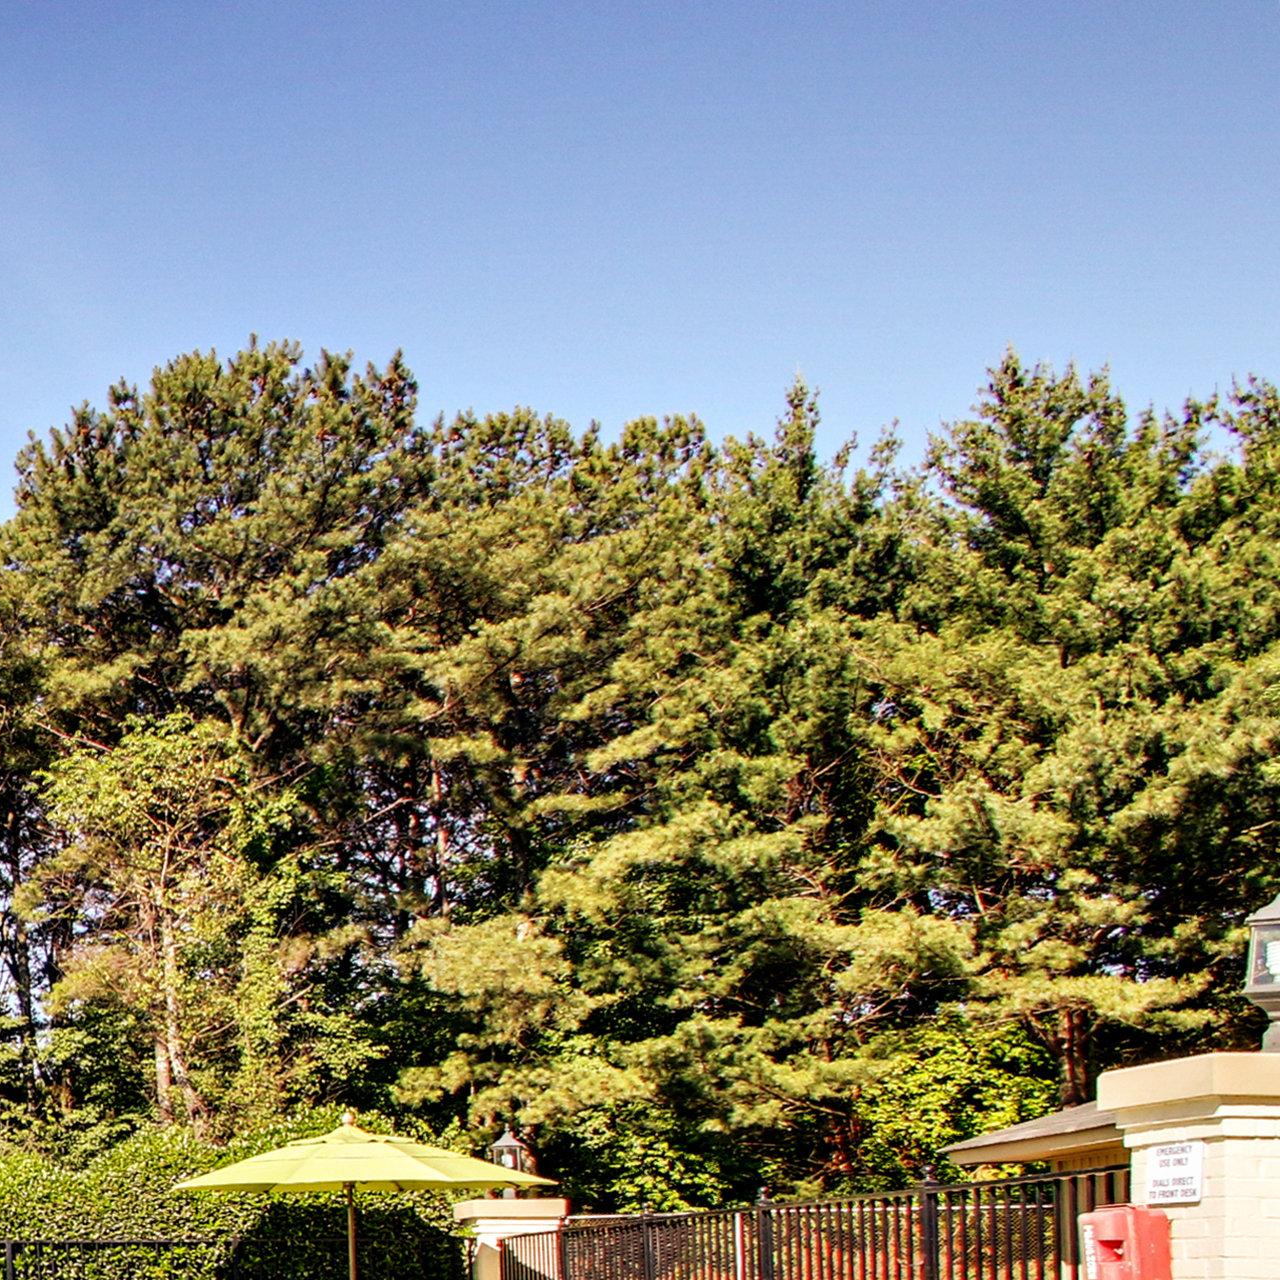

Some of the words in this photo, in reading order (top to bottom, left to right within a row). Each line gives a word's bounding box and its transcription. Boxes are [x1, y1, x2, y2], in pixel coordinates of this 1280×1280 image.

[1156, 1145, 1192, 1157] EMERGENCY
[1159, 1158, 1171, 1168] USE
[1172, 1157, 1188, 1166] ONLY
